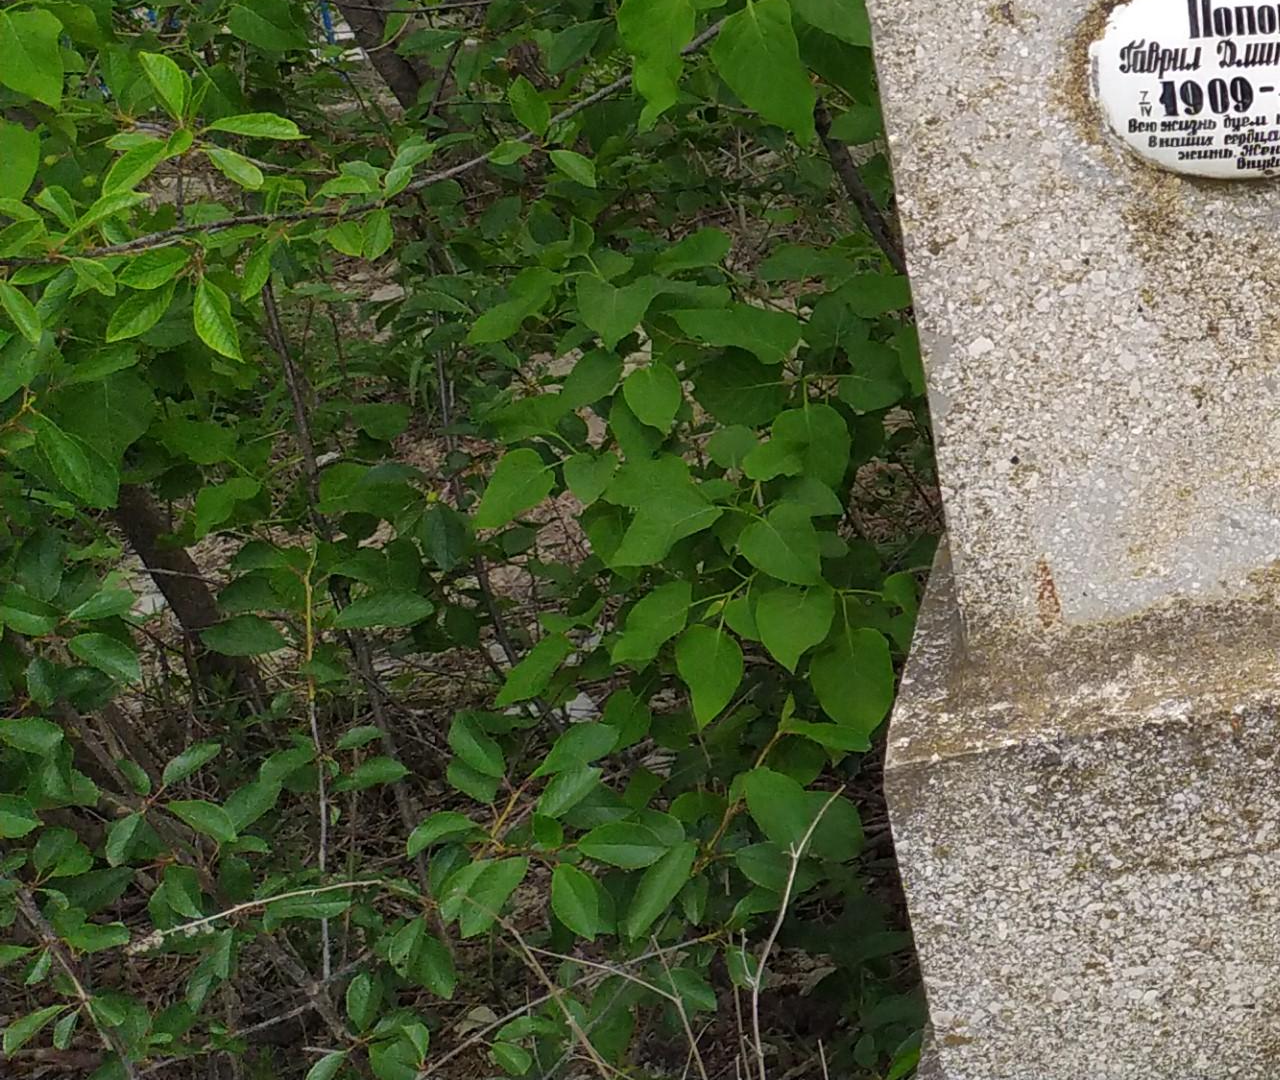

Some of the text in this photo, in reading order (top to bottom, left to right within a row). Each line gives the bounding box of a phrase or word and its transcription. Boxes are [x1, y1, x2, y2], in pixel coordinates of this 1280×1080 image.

[1119, 39, 1202, 79] Гаврил
[1128, 118, 1157, 133] Всю
[1160, 119, 1217, 136] жизнь
